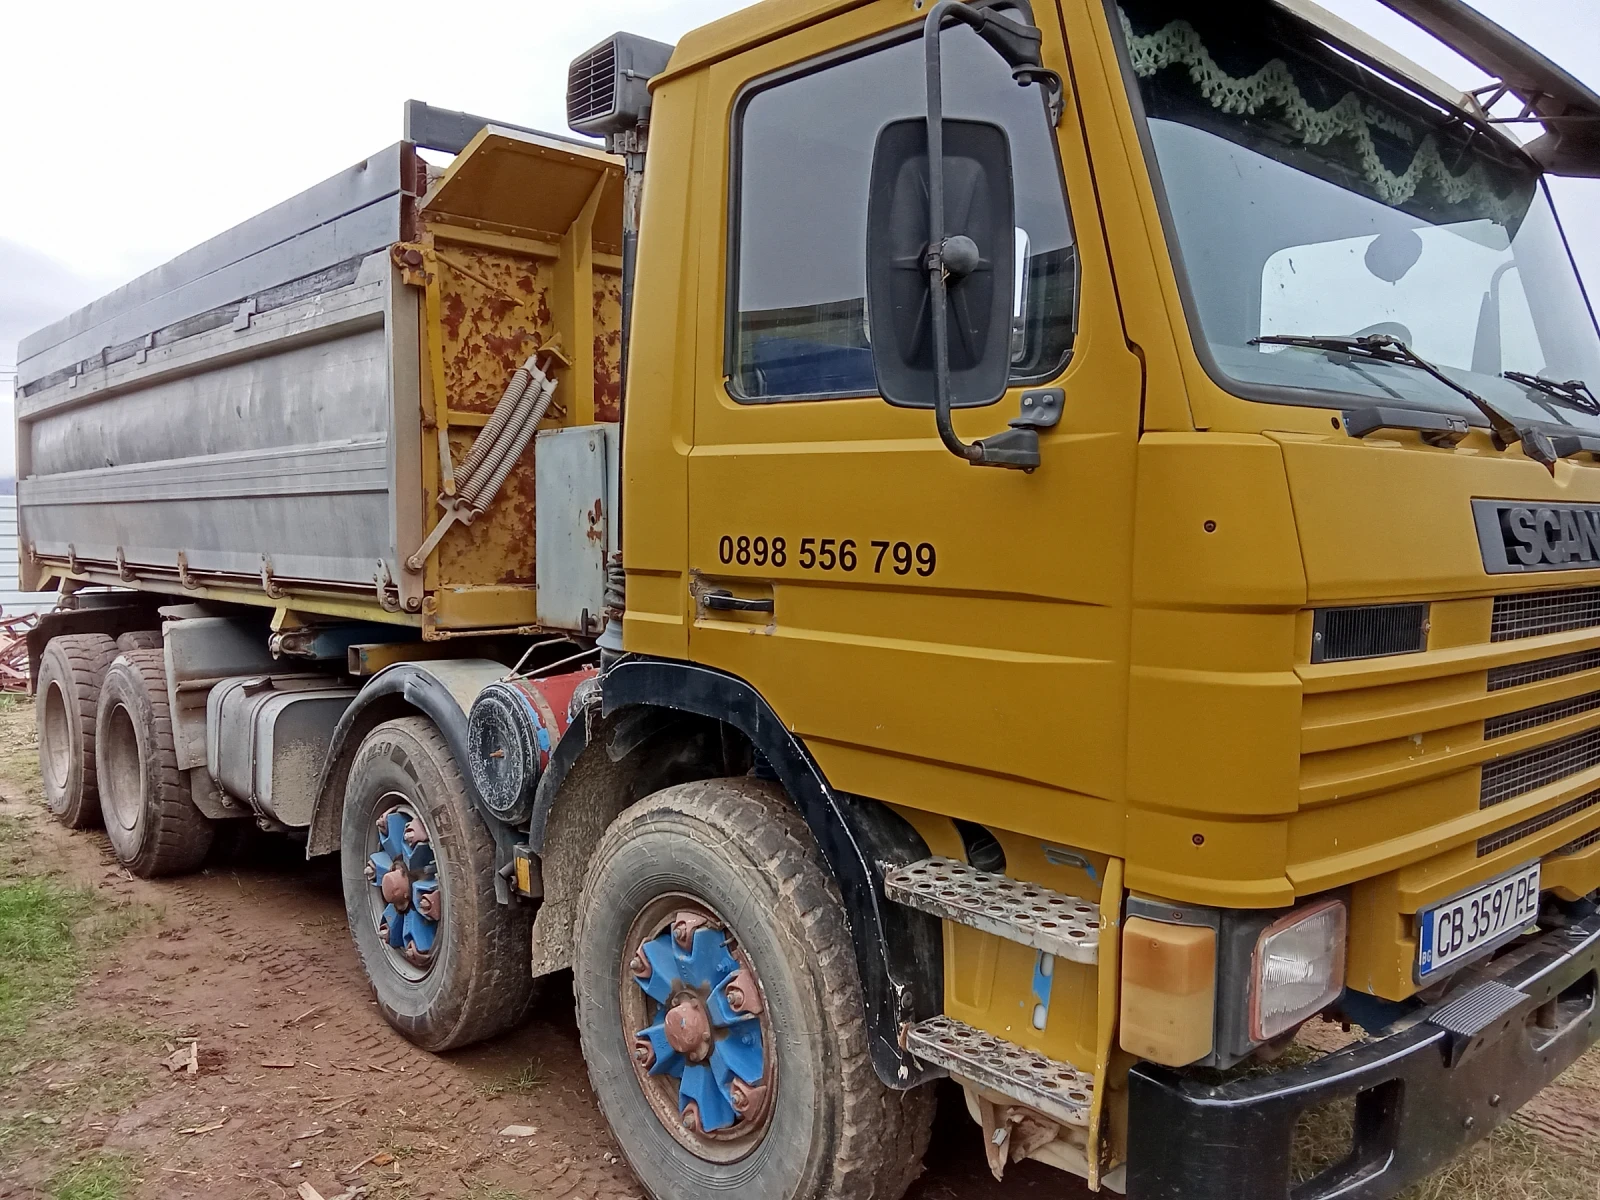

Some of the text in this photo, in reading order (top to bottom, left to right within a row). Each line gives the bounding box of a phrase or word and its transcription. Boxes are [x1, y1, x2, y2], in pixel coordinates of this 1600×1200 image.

[719, 535, 937, 577] 0898 556 799
[1438, 907, 1463, 958] CB
[1467, 883, 1514, 943] 3597
[1421, 949, 1432, 966] BG
